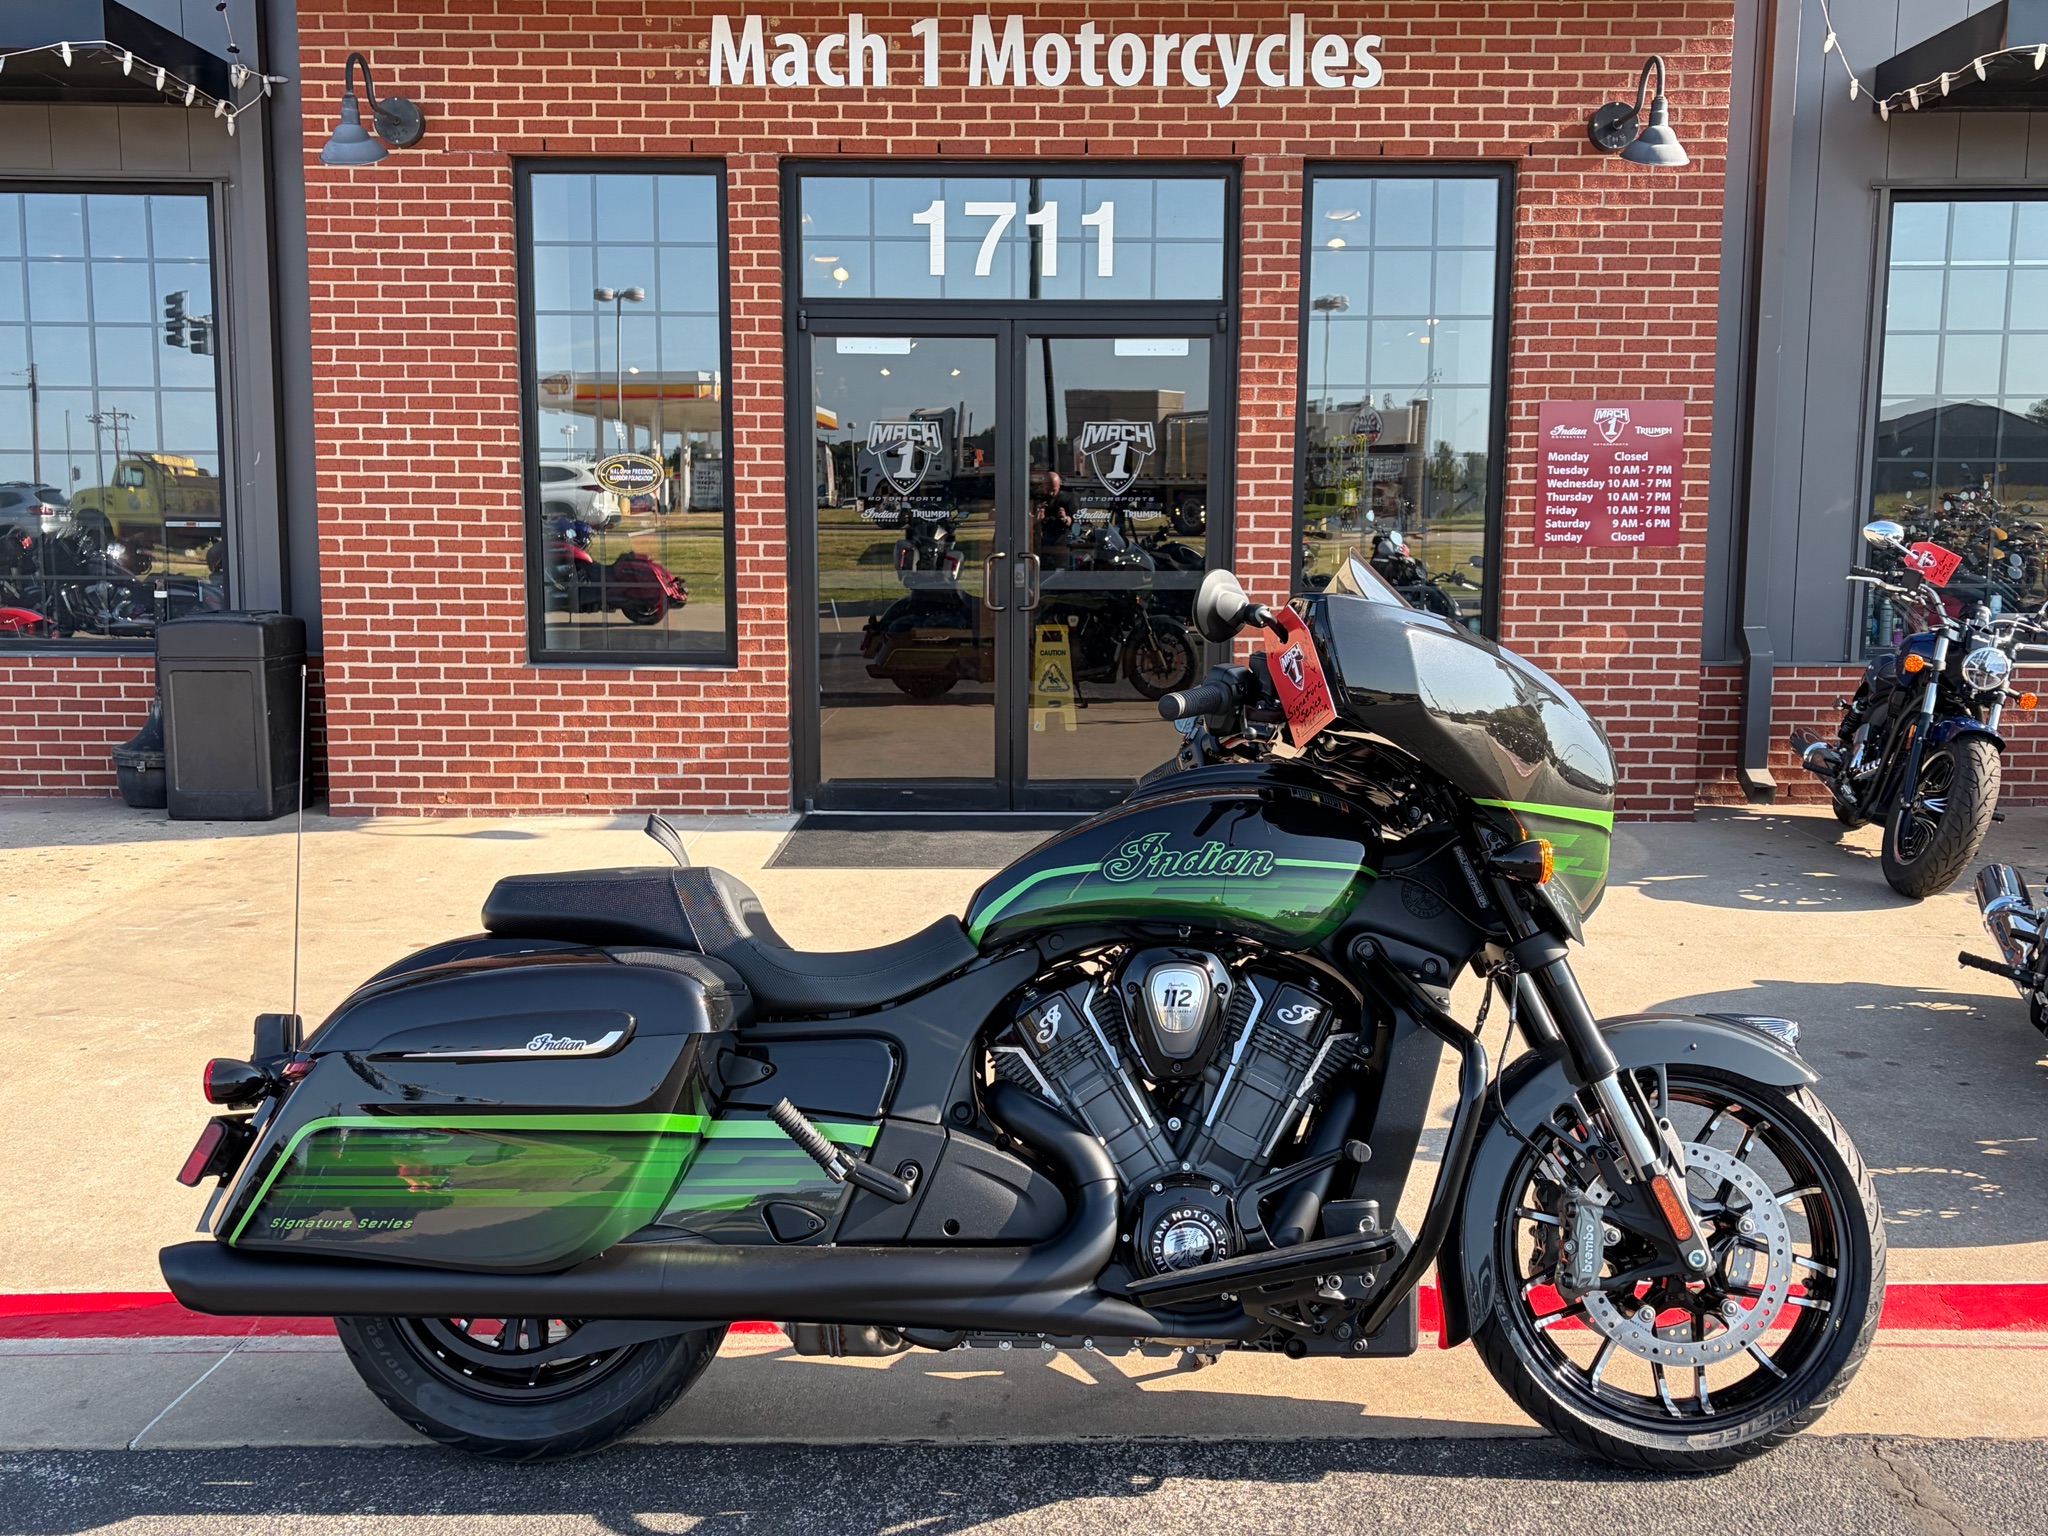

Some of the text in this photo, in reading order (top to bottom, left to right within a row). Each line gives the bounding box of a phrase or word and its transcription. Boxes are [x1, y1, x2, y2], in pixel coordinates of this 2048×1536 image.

[708, 13, 1383, 108] Mach 1 Motorcycles
[912, 200, 1114, 278] 1711
[1596, 410, 1629, 421] MACH
[1550, 424, 1588, 436] Indian
[1605, 417, 1618, 435] 1
[1635, 426, 1673, 436] TRIUMPH
[871, 424, 939, 446] MACH
[1084, 424, 1151, 446] MACH
[892, 441, 917, 479] 1
[1106, 441, 1130, 479] 1
[1548, 452, 1649, 463] Monday Closed
[1547, 466, 1589, 476] Tuesday
[1609, 466, 1621, 474] 10
[1622, 466, 1640, 474] AM
[1648, 466, 1655, 474] 7
[1656, 466, 1672, 474] PM
[1547, 479, 1605, 490] Wednesday
[1608, 479, 1621, 487] 10
[1622, 479, 1639, 487] AM
[1647, 479, 1654, 487] 7
[1655, 479, 1671, 487] PM
[1546, 492, 1593, 503] Thursday
[1607, 493, 1620, 501] 10
[1621, 493, 1638, 501] AM
[1646, 493, 1653, 501] 7
[1655, 493, 1671, 501] PM
[861, 507, 950, 519] Indian TRIUMPH
[1073, 508, 1162, 519] Indian TRIUMPH
[1546, 506, 1577, 516] Friday
[1607, 506, 1619, 514] 10
[1620, 506, 1638, 514] AM
[1646, 506, 1652, 514] 7
[1654, 506, 1670, 514] PM
[1545, 519, 1591, 530] Saturday
[1612, 519, 1618, 528] 9
[1620, 519, 1637, 528] AM
[1645, 519, 1652, 528] 6
[1654, 519, 1670, 528] PM
[1545, 532, 1645, 543] Sunday Closed
[1281, 645, 1303, 669] MACH
[1103, 832, 1274, 882] Indian
[1163, 989, 1193, 1007] 112
[527, 1033, 587, 1052] Indian
[270, 1217, 414, 1230] Signature Series
[1153, 1209, 1227, 1271] INDIAN MOTORCYC
[1581, 1224, 1595, 1273] brembo
